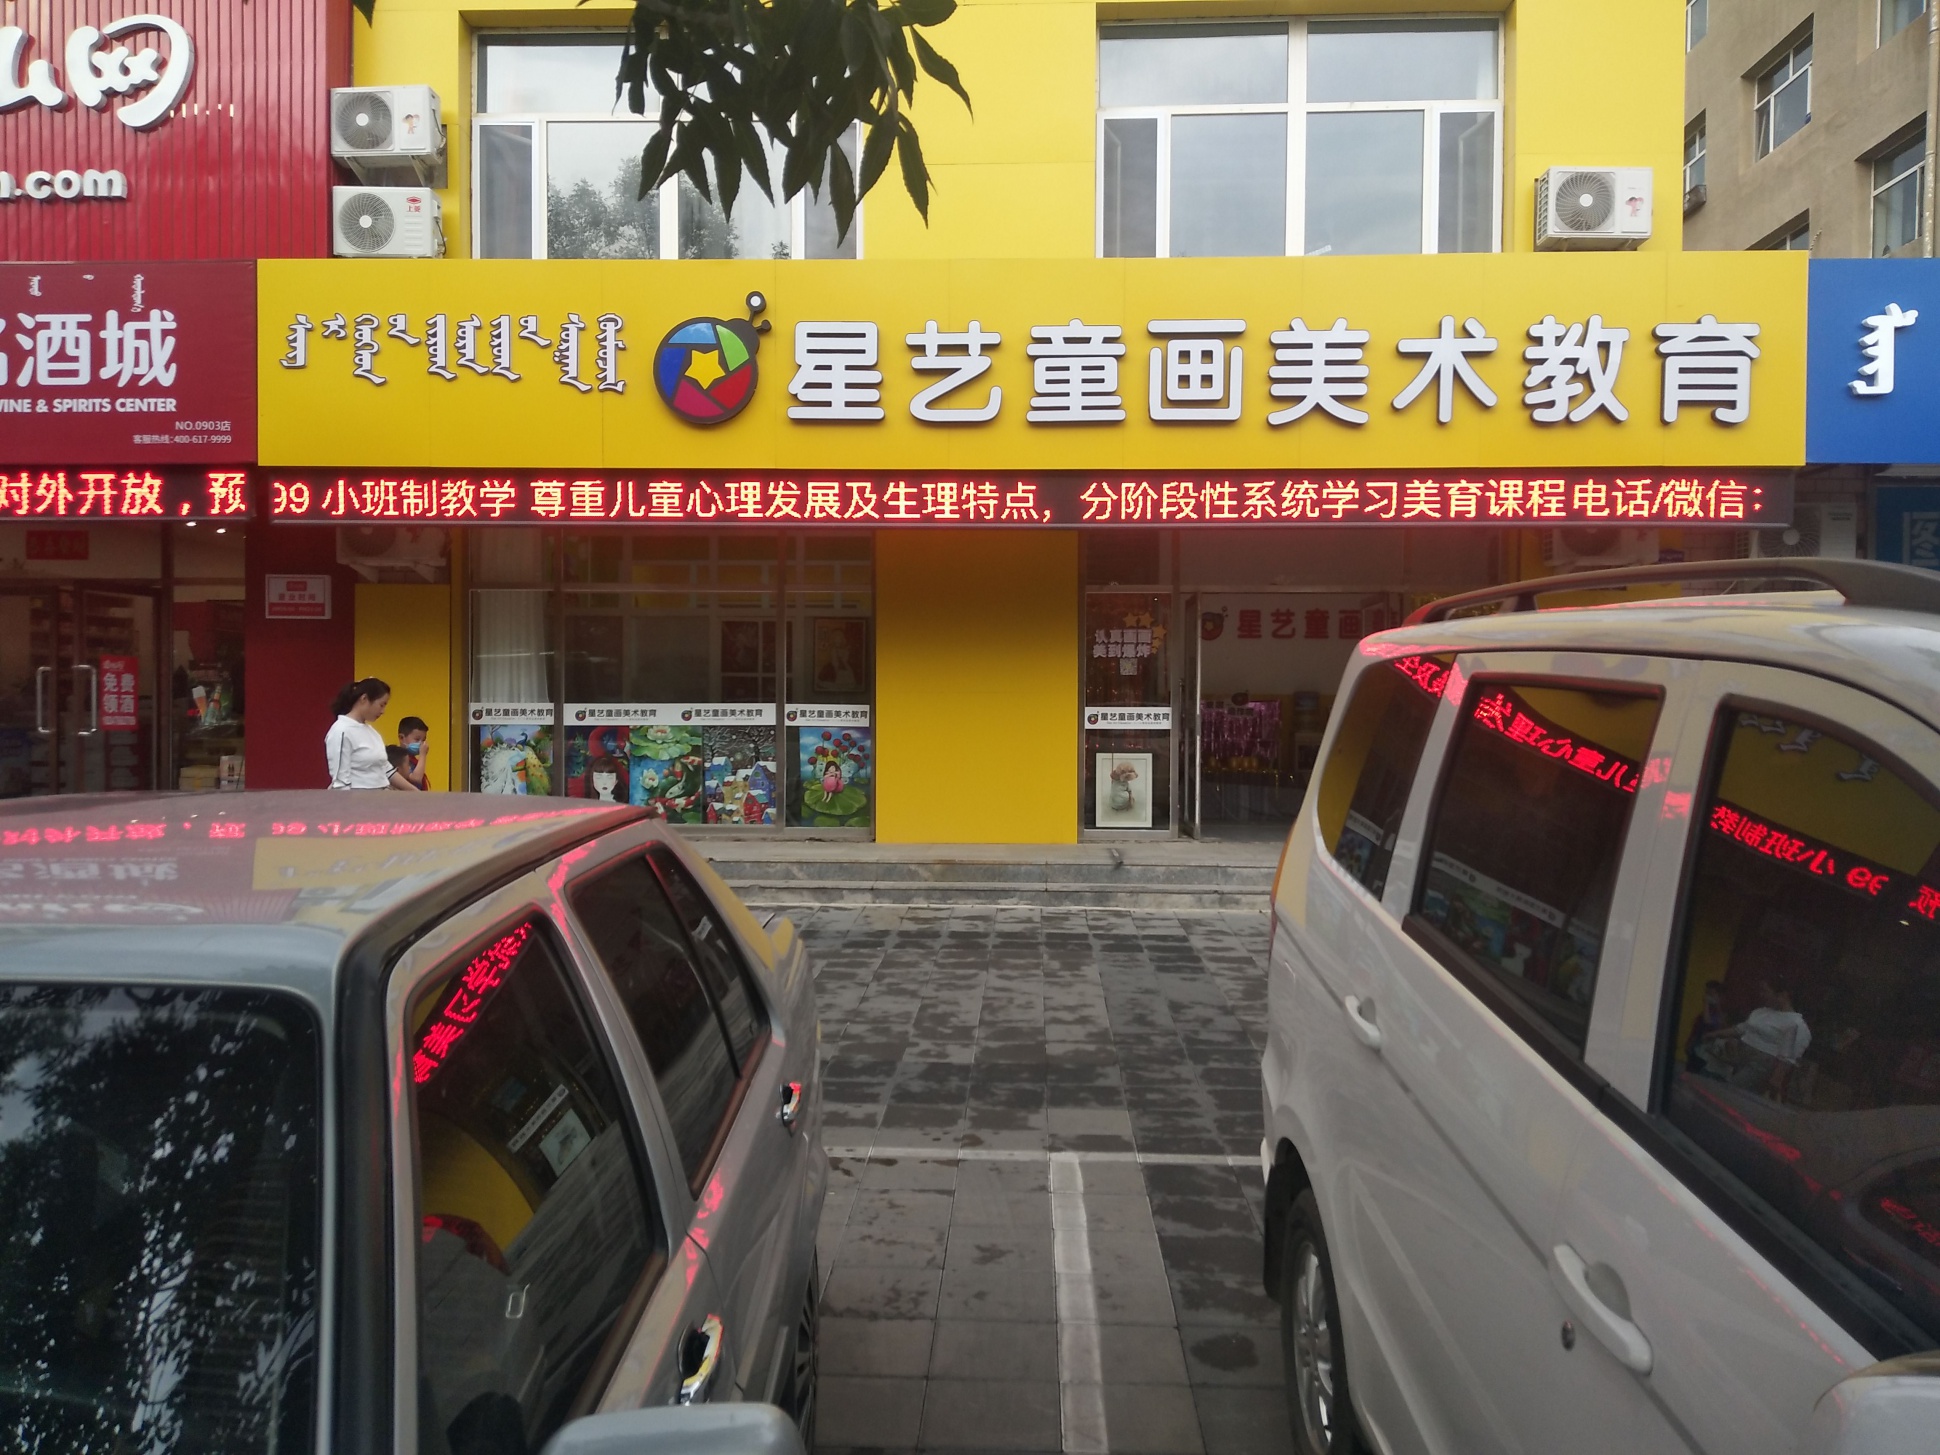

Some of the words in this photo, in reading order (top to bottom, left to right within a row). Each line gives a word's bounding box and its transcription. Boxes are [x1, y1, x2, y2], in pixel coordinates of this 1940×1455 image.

[787, 314, 1761, 426] 星艺童画美术教育
[36, 398, 49, 413] &
[53, 398, 112, 413] SPIRITS
[115, 398, 178, 412] CENTER
